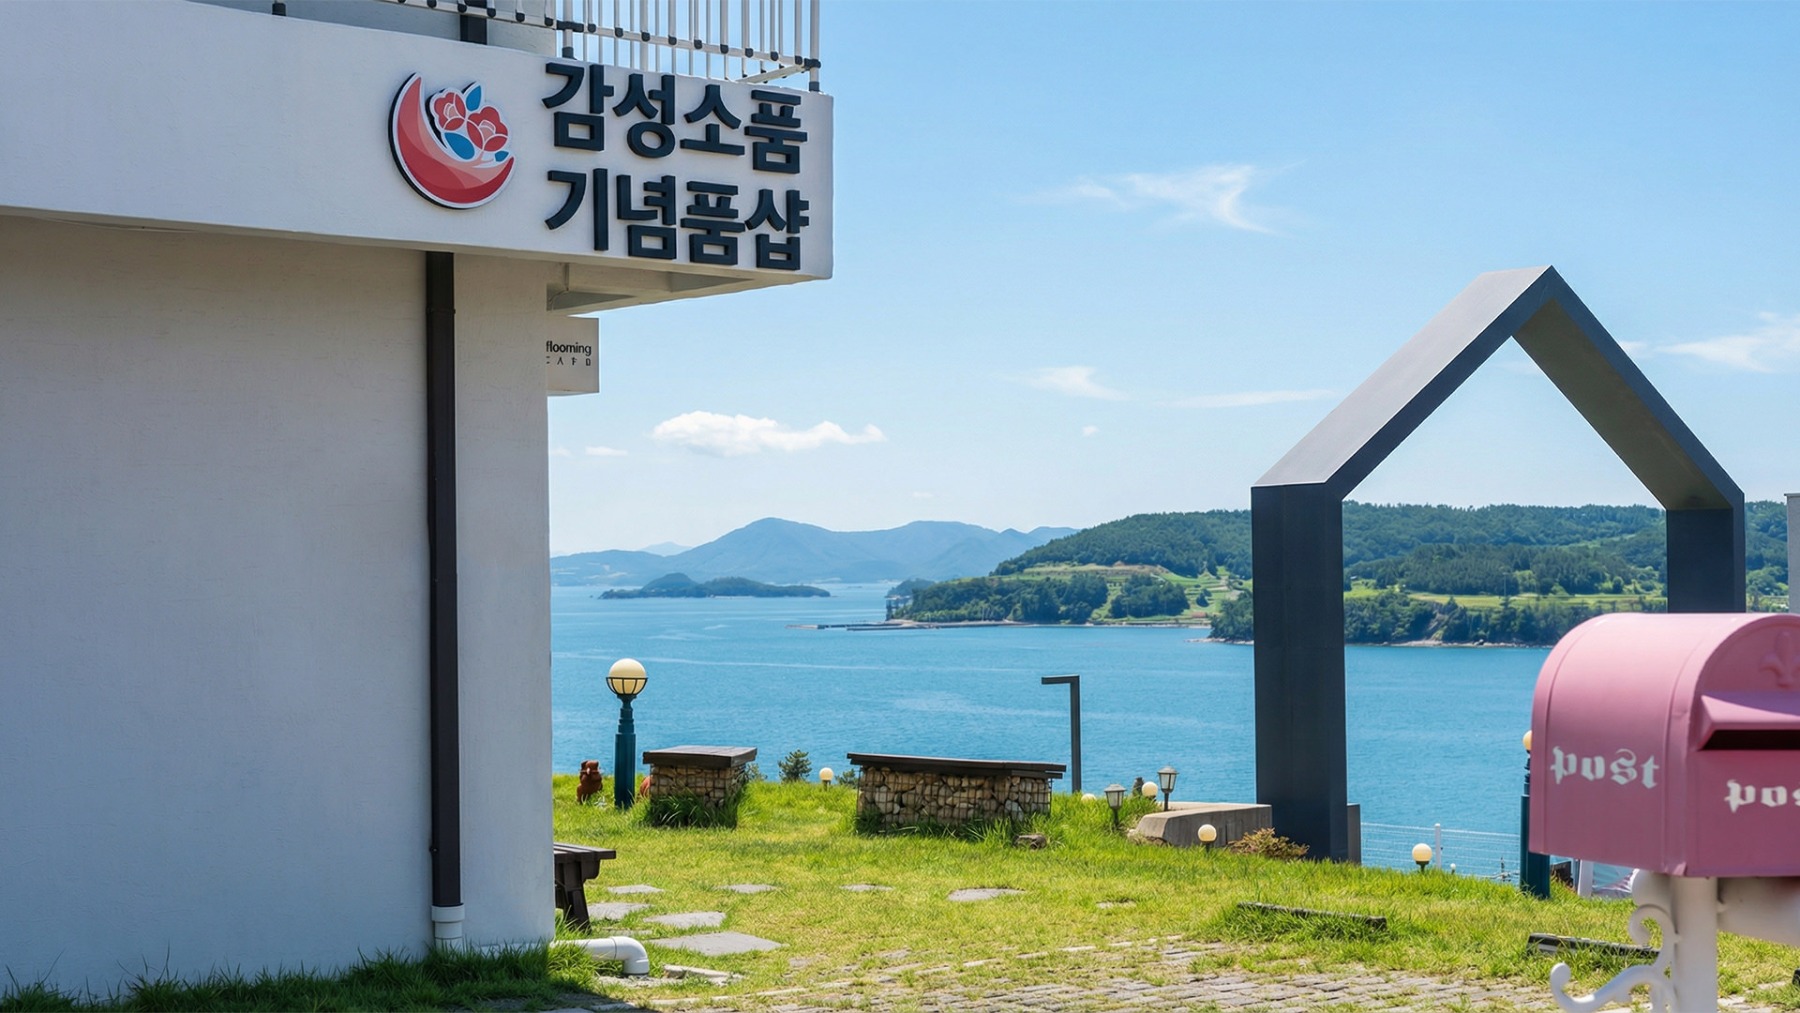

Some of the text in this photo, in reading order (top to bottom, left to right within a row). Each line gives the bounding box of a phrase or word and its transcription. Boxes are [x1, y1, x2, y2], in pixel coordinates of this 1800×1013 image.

[542, 63, 808, 174] 감성소품
[544, 168, 810, 270] 기념품샵
[1550, 746, 1660, 789] post
